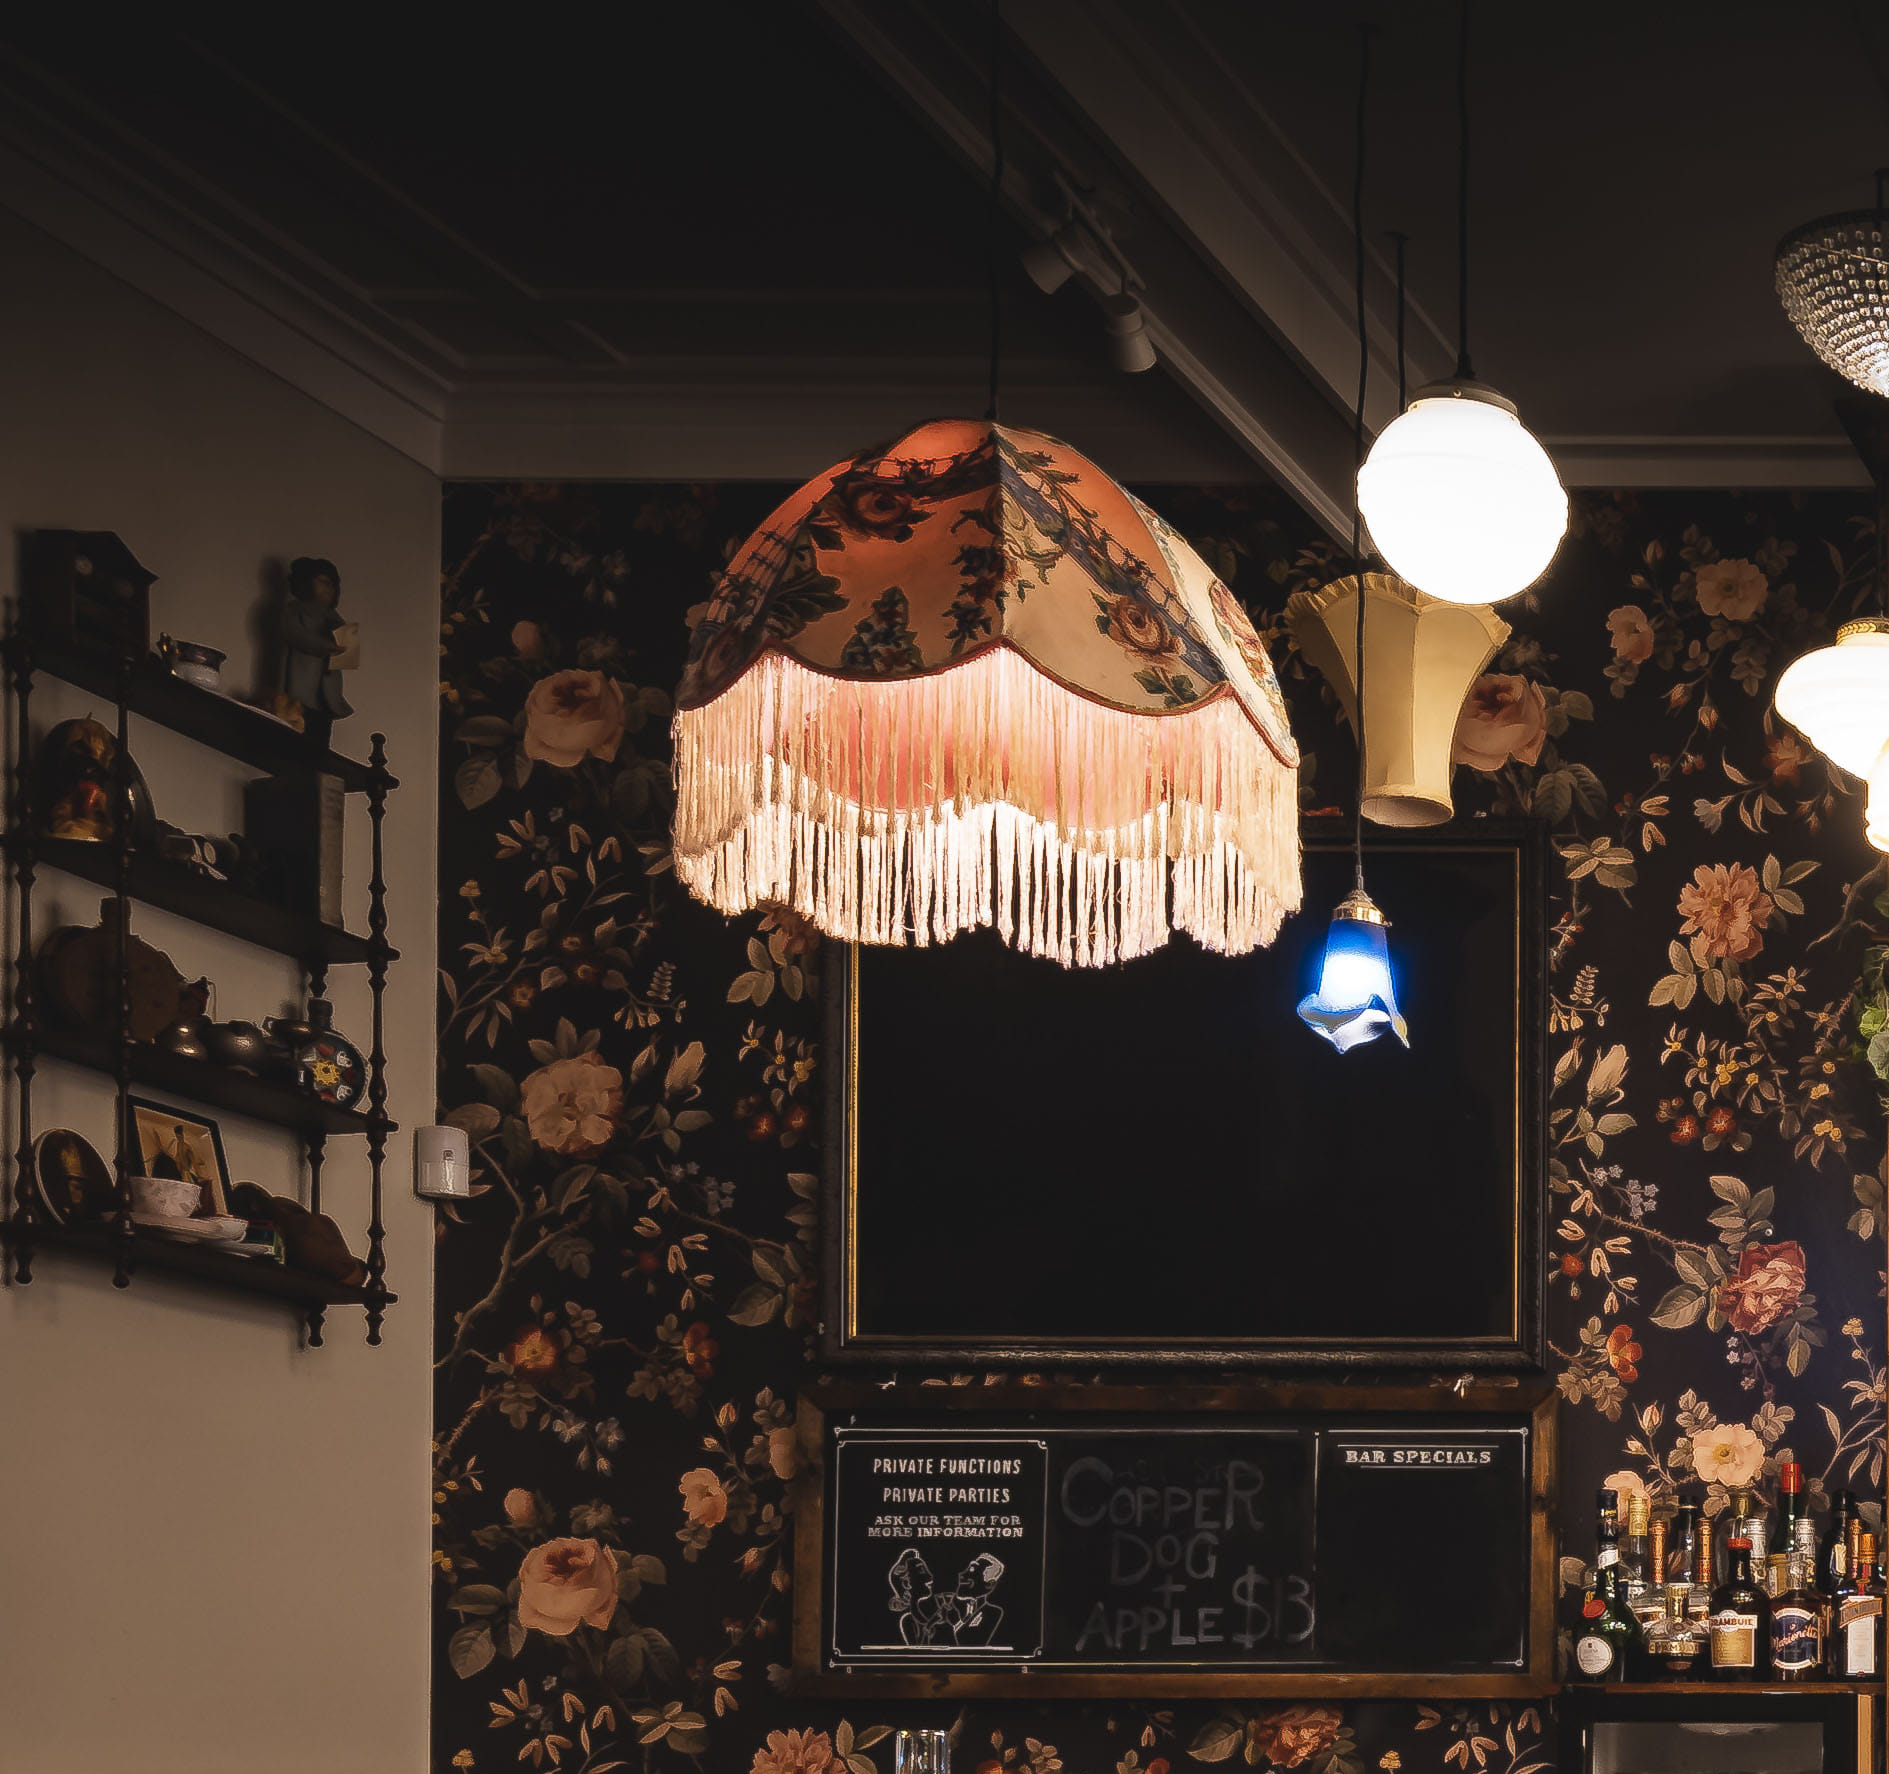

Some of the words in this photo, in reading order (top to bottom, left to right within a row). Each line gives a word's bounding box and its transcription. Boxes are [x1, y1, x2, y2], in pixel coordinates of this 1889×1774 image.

[1345, 1450, 1385, 1464] BAR
[1393, 1450, 1492, 1465] SPECIALS
[873, 1457, 935, 1475] PRIVATE
[939, 1457, 1022, 1476] FUNCTIONS
[883, 1486, 944, 1505] PRIVATE
[949, 1486, 1010, 1504] PARTIES
[875, 1515, 904, 1526] ASK
[909, 1515, 940, 1526] OUR
[944, 1515, 986, 1526] TEAM
[991, 1515, 1021, 1526] FOR
[867, 1526, 912, 1537] MORE
[917, 1526, 1024, 1538] INFORMATION
[1076, 1601, 1224, 1650] APPLE
[1233, 1565, 1315, 1650] $13
